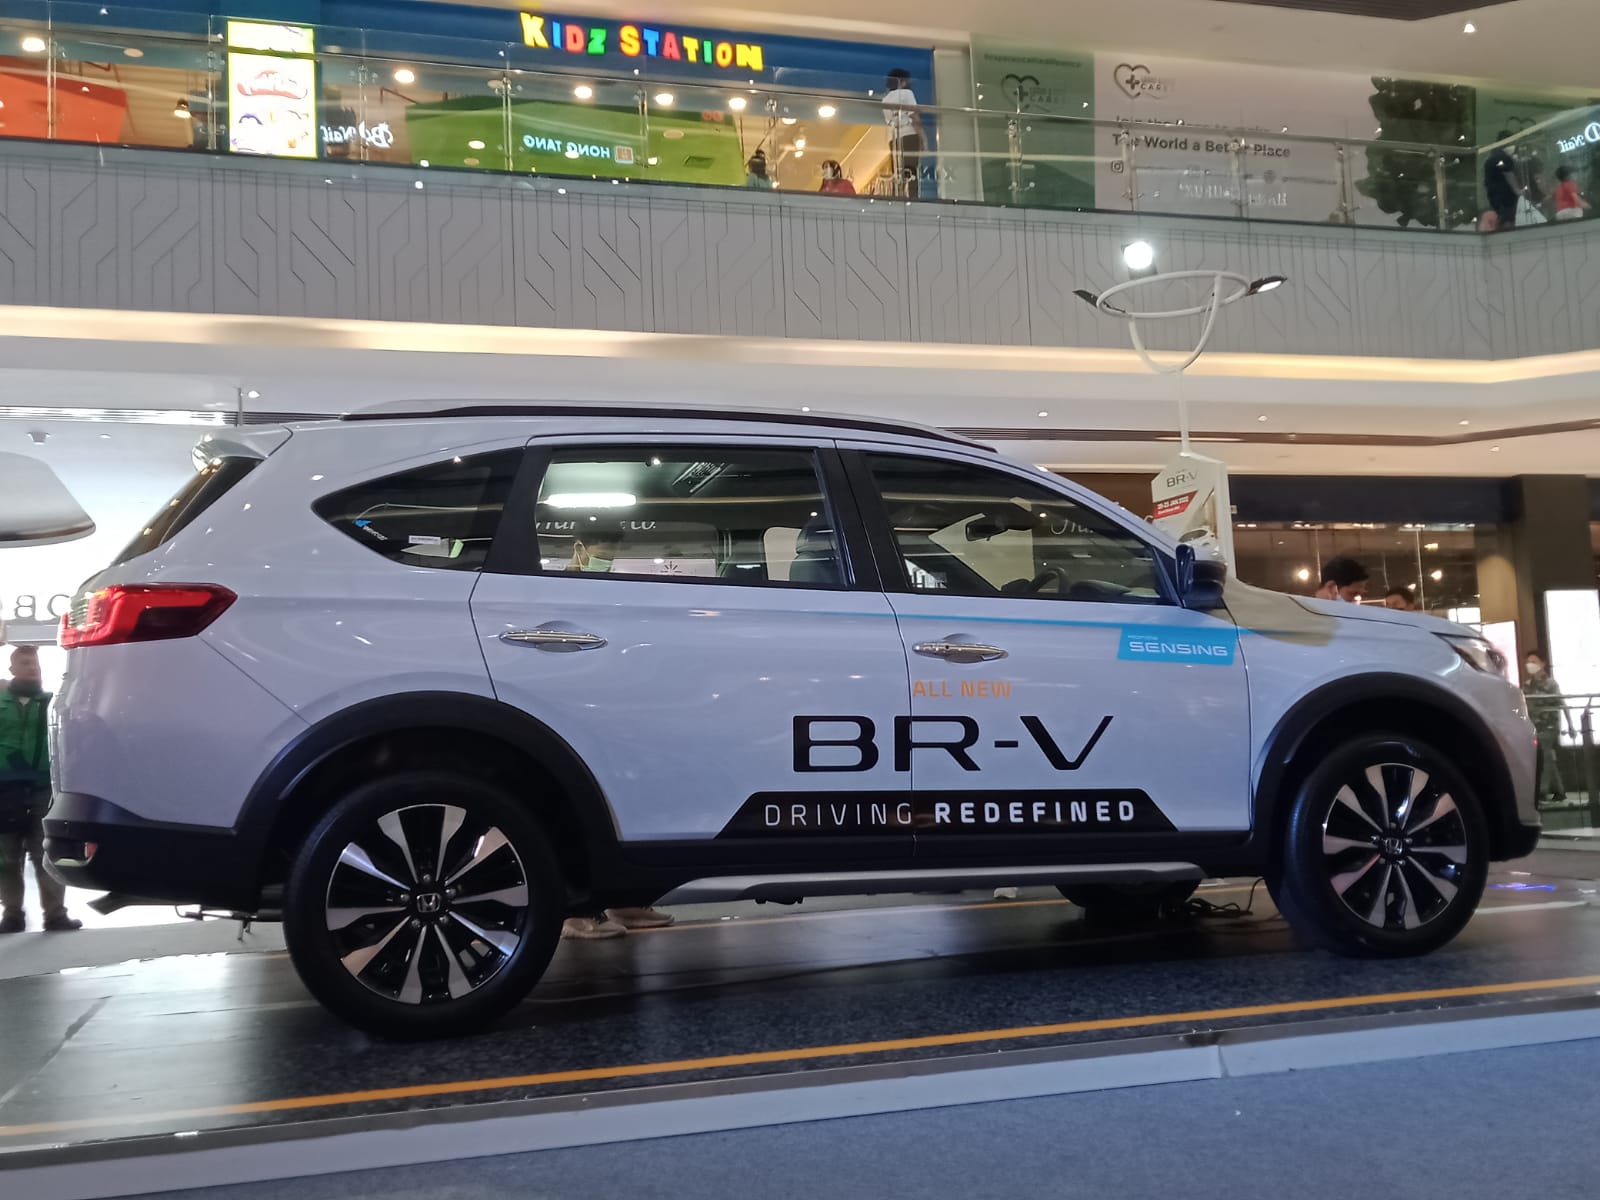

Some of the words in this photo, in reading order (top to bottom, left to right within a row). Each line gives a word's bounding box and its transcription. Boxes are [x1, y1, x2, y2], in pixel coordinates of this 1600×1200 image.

[519, 11, 607, 55] KIDZ
[619, 24, 764, 71] STATION
[1144, 135, 1188, 150] World
[1192, 142, 1201, 151] a
[1253, 143, 1290, 157] Place
[1129, 641, 1228, 656] SENSING
[913, 680, 952, 697] ALL
[960, 680, 1012, 698] NEW
[793, 715, 1114, 772] BR-V
[764, 803, 912, 826] DRIVING
[934, 800, 1135, 824] REDEFINED
